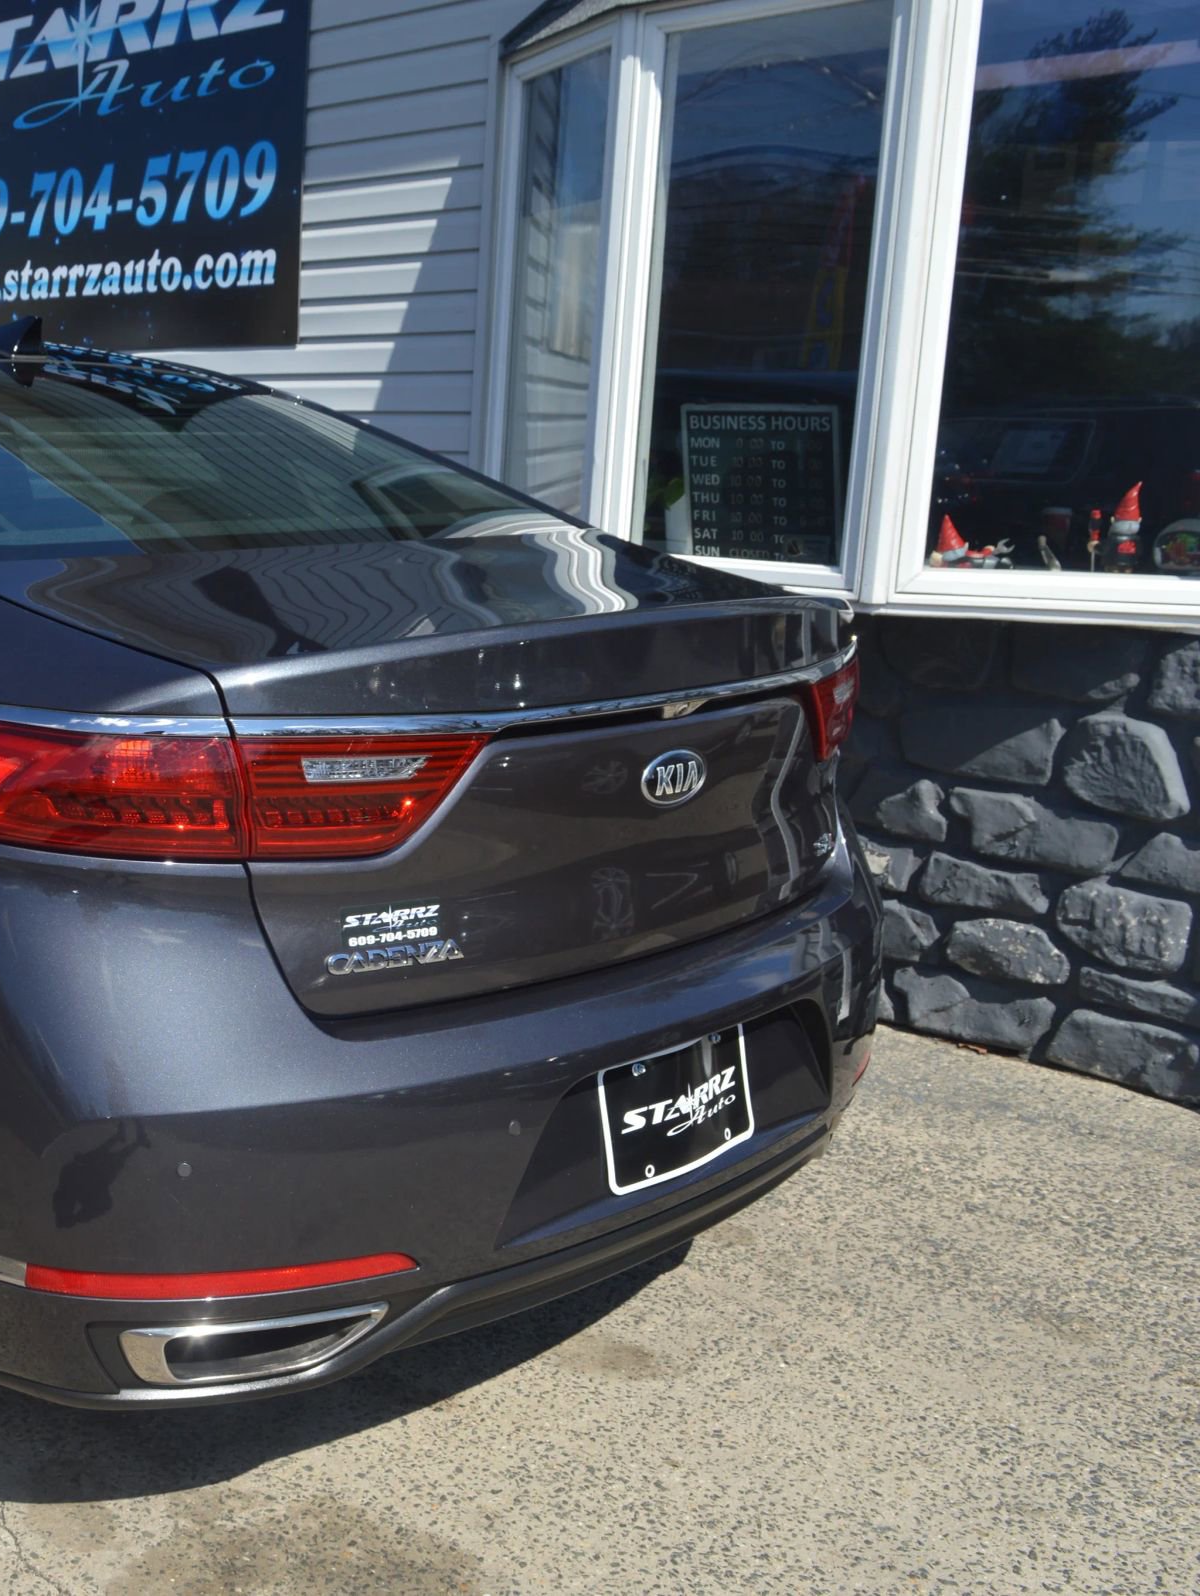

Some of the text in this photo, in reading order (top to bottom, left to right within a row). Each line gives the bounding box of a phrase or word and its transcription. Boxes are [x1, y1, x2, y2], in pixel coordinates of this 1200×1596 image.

[12, 57, 276, 130] Auto
[689, 415, 831, 432] BUSINESS HOURS
[690, 437, 720, 449] MON
[770, 440, 787, 451] TO
[691, 455, 718, 467] TUE
[770, 459, 787, 470] TO
[691, 474, 720, 486] WED
[771, 478, 788, 489] TO
[692, 491, 720, 504] THU
[772, 496, 788, 508] TO
[693, 510, 716, 522] FRI
[773, 515, 788, 527] TO
[694, 528, 718, 540] SAT
[694, 545, 720, 558] SUN
[654, 760, 699, 797] KIA
[342, 904, 440, 929] STARRZ
[348, 926, 438, 947] 609-704-5709
[325, 938, 465, 976] CADENZA
[621, 1065, 736, 1135] STARRZ
[666, 1094, 736, 1137] Auto
